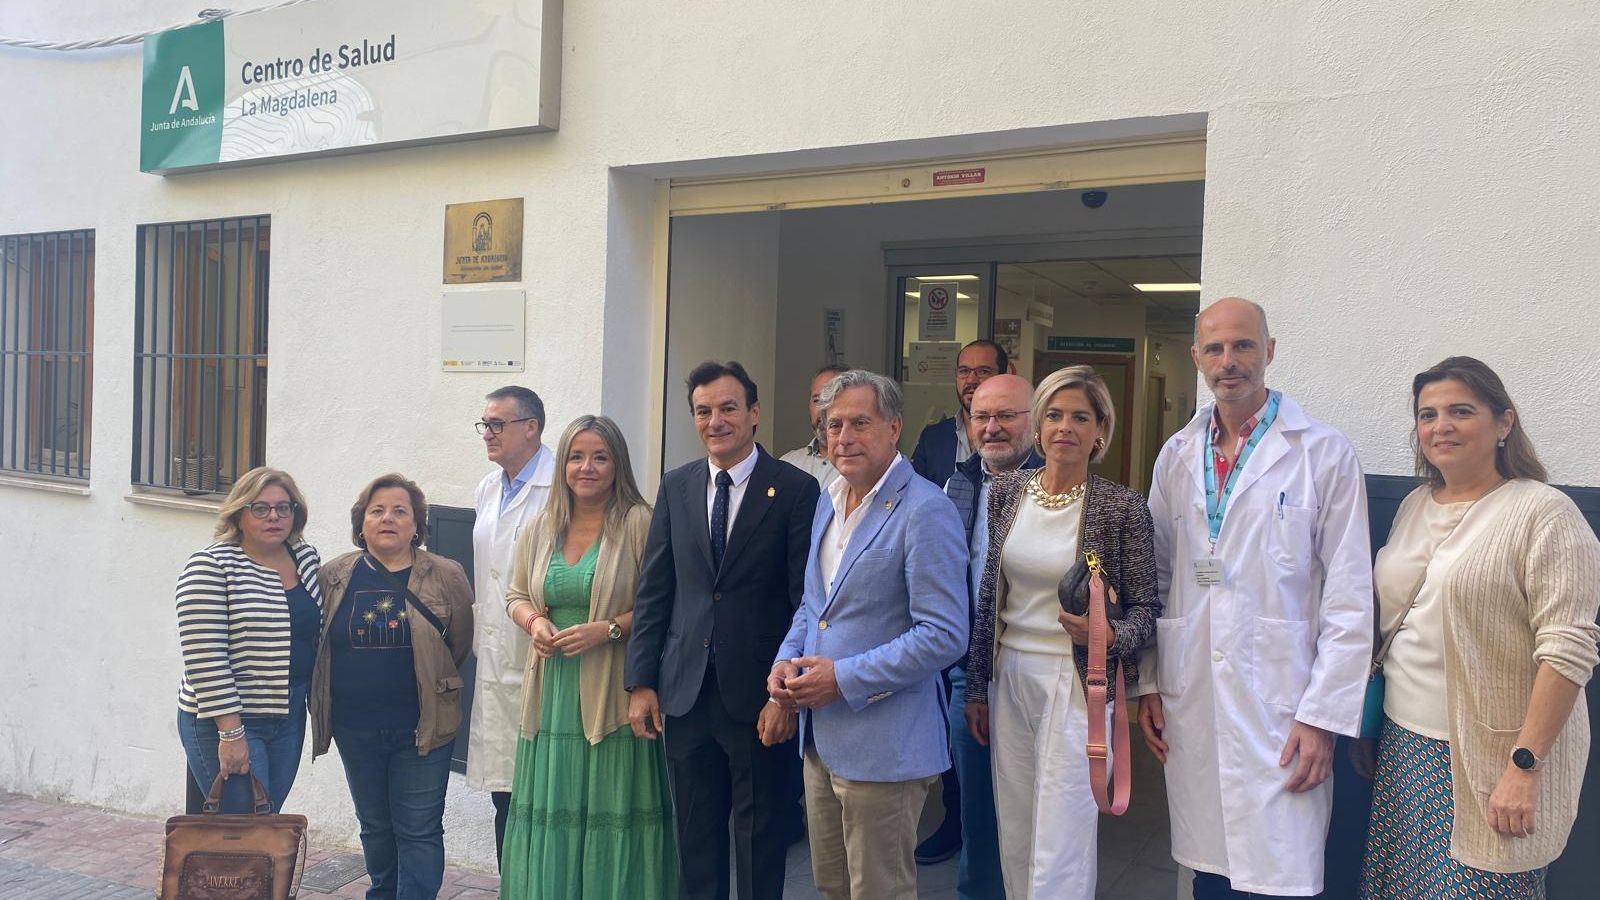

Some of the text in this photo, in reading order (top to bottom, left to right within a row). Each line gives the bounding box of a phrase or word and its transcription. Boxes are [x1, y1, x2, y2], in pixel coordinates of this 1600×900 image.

[241, 34, 396, 85] Centro de Salud
[241, 88, 338, 117] La Magdalena
[150, 121, 170, 132] Junta
[171, 118, 181, 129] de
